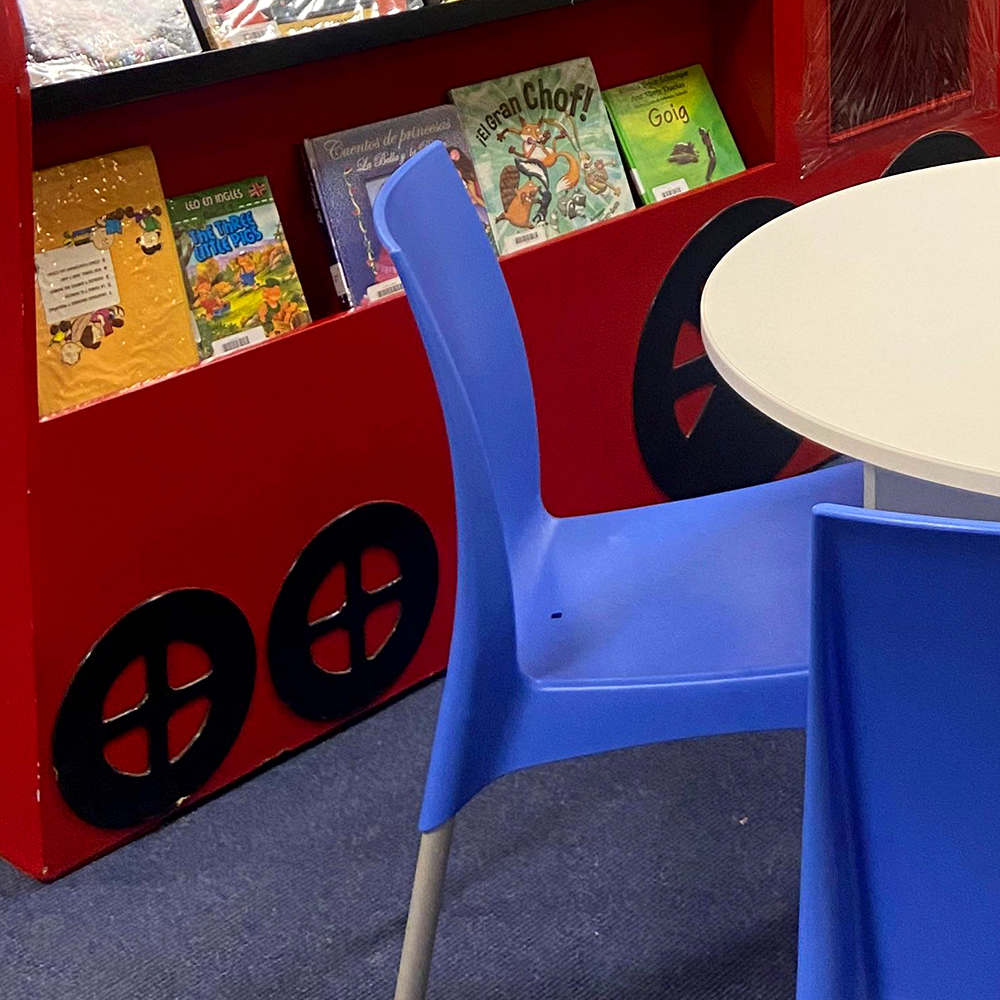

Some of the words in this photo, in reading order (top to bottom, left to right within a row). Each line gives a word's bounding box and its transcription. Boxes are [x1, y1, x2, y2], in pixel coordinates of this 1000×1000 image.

[475, 124, 491, 148] ¡El
[484, 94, 522, 130] Gran
[522, 78, 595, 122] Chof!
[648, 103, 689, 127] Goig
[324, 138, 380, 160] Cuentos
[383, 129, 396, 146] de
[399, 118, 451, 149] princesas
[356, 156, 372, 172] La
